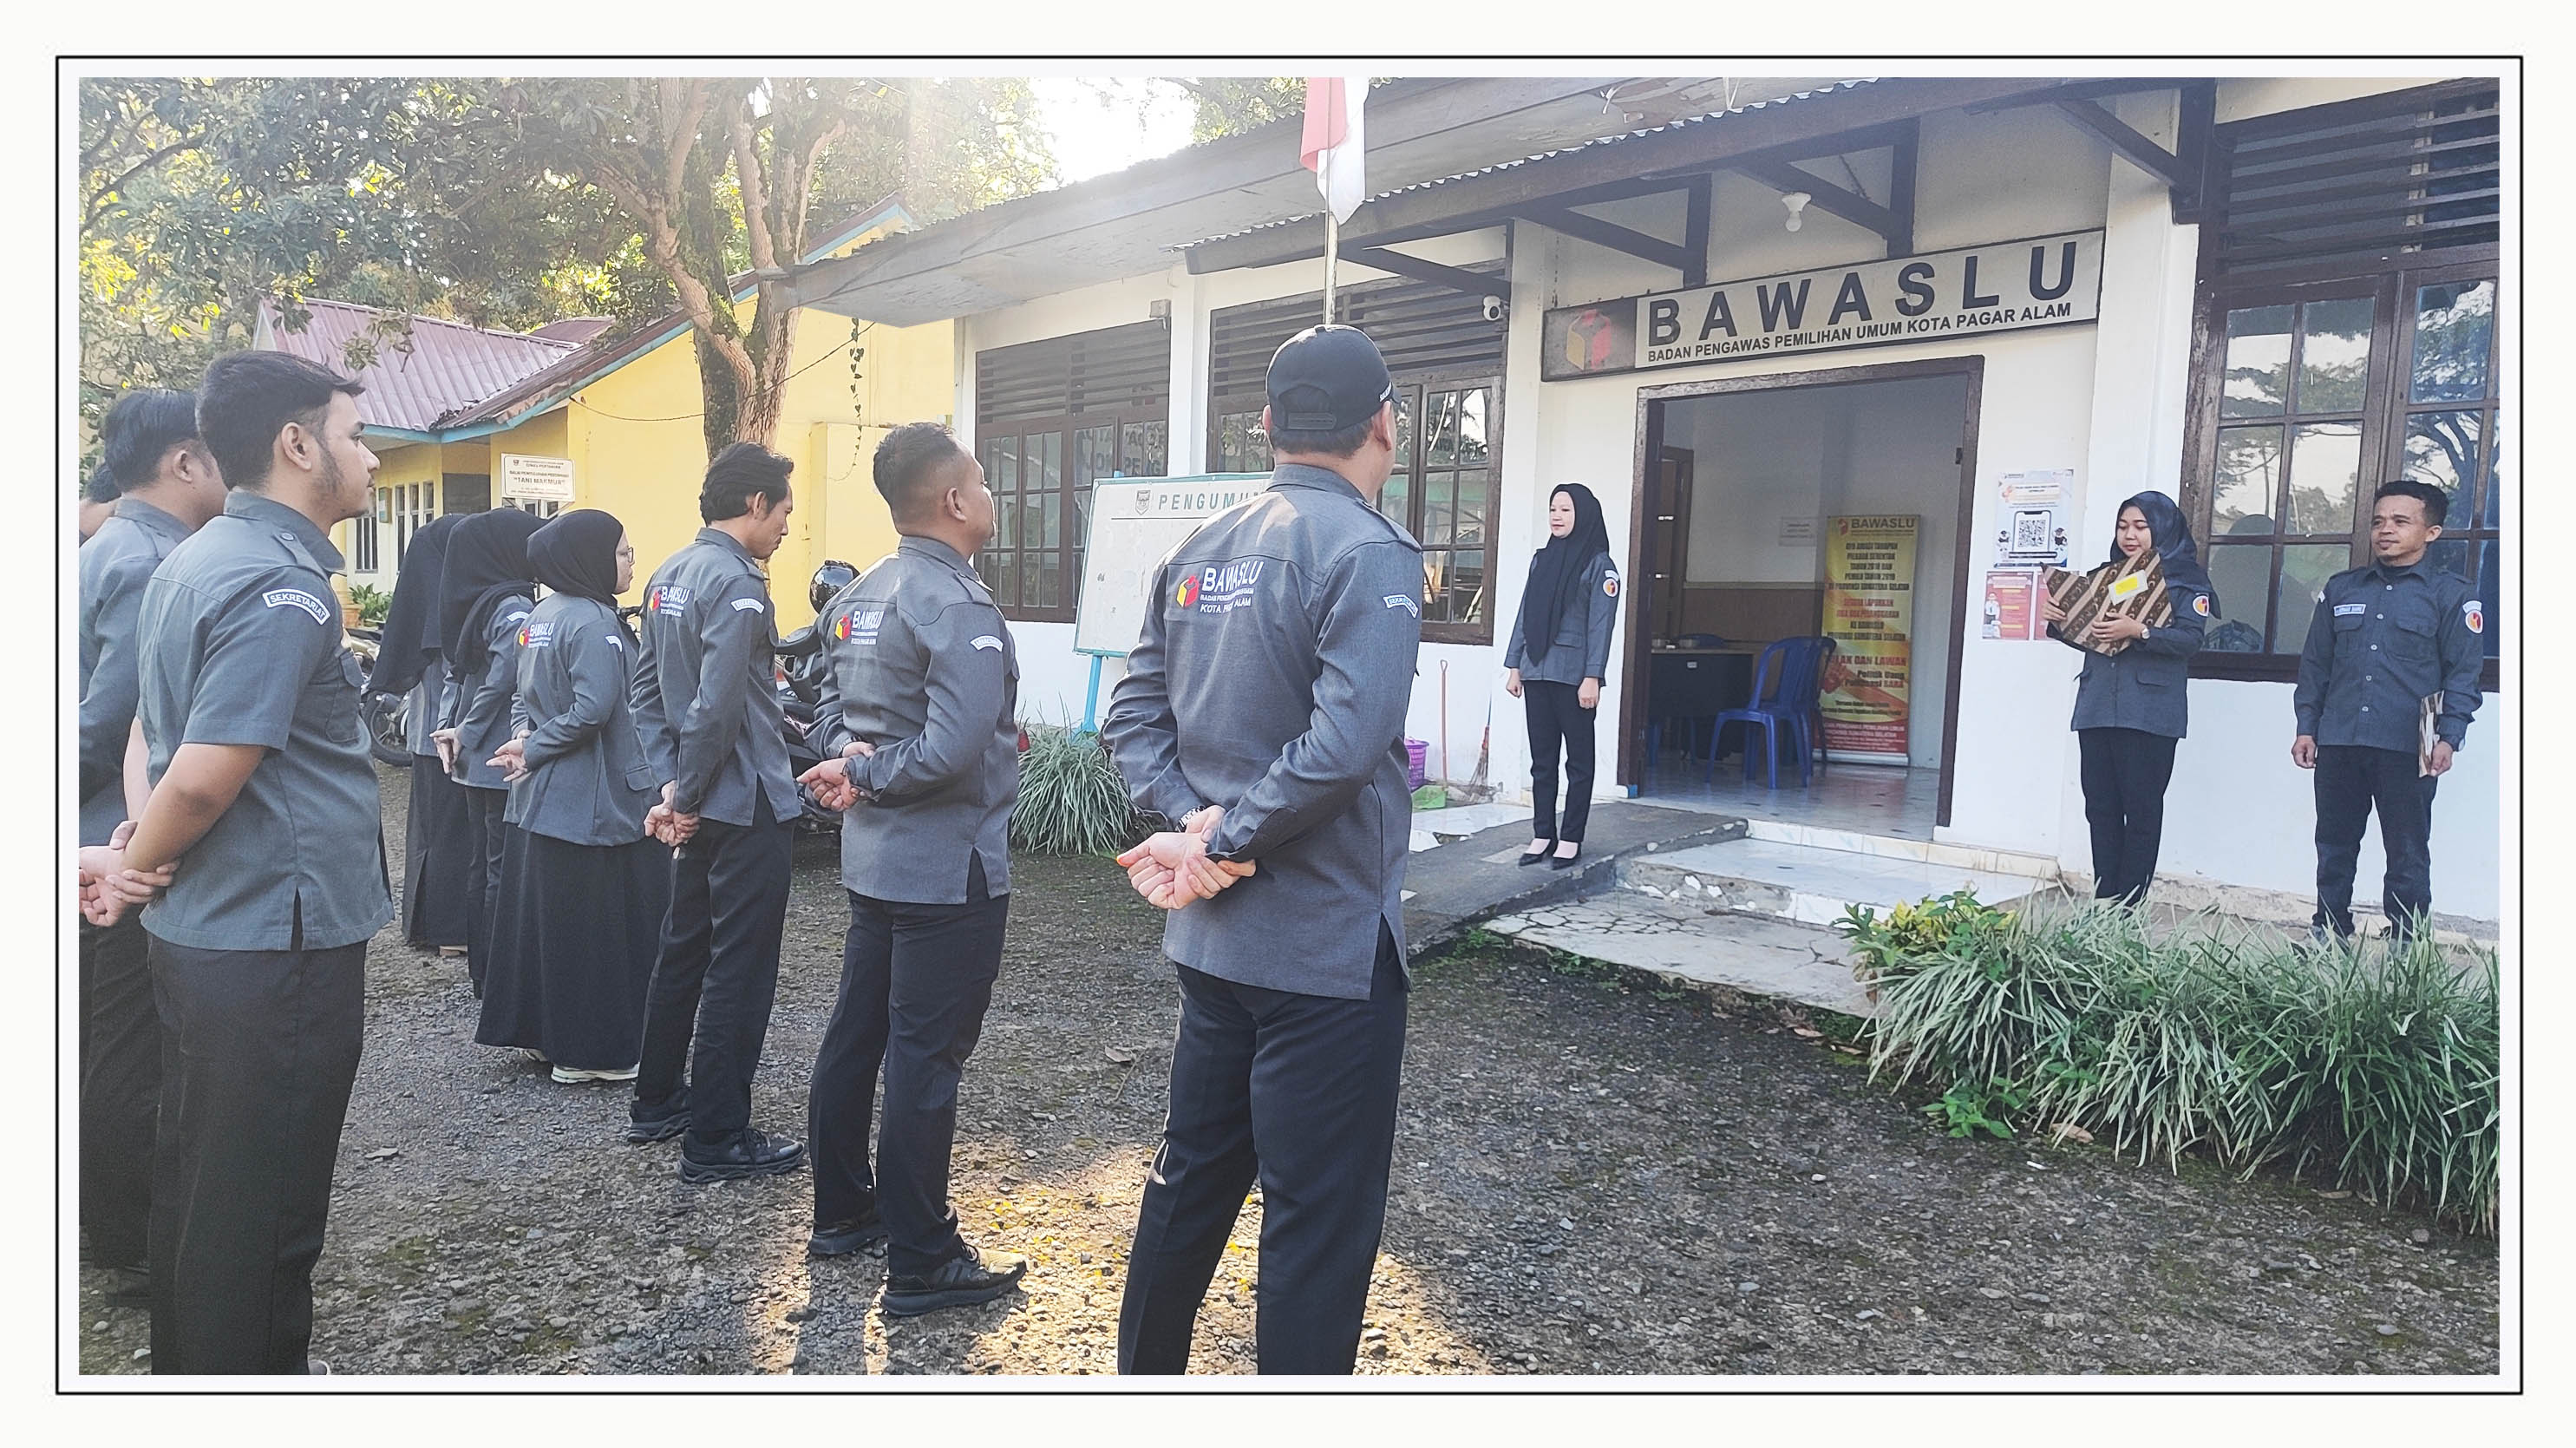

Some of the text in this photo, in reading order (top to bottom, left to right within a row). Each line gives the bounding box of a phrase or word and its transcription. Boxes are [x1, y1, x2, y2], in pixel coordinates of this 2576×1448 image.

[1649, 241, 2077, 347] BAWASLU
[1648, 302, 2071, 362] BADAN PENGAWAS PEMILIHAN UMUM KOTA PAGAR ALAM
[1852, 518, 1915, 528] BAWASLU
[1202, 560, 1264, 593] BAWASLU
[270, 593, 325, 619] SEKRETARIAT
[1200, 604, 1221, 613] KOTA
